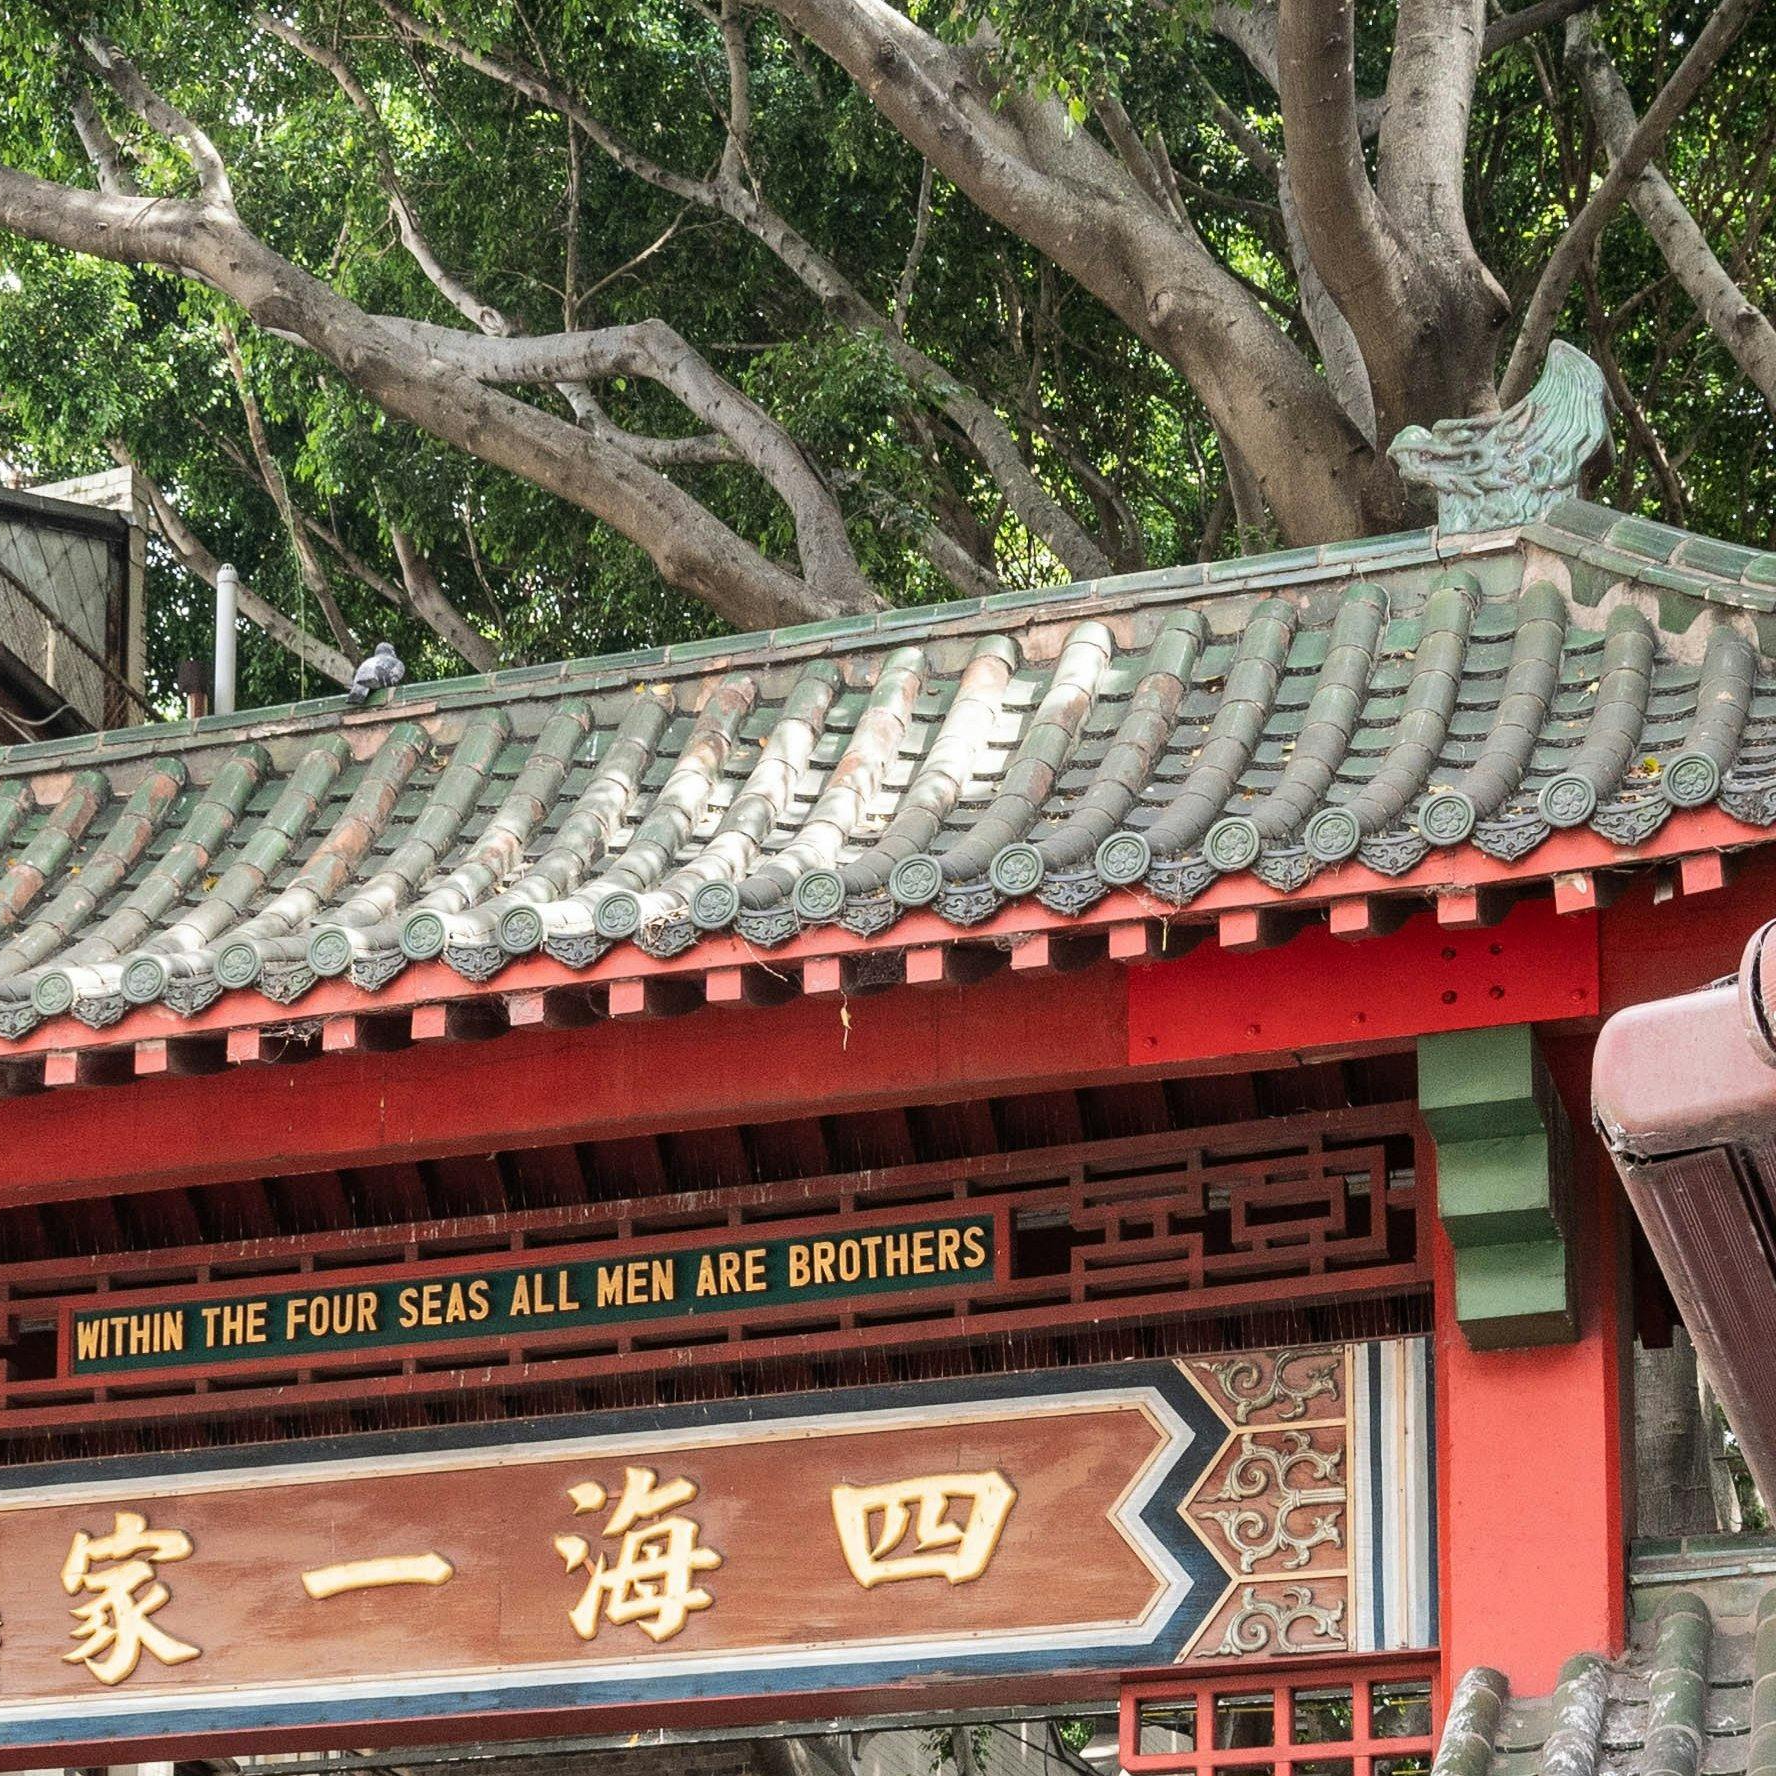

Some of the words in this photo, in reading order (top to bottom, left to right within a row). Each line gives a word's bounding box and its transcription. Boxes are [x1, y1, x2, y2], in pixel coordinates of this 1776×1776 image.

[77, 1310, 184, 1361] WITHIN
[201, 1301, 268, 1348] THE
[286, 1291, 378, 1340] FOUR
[398, 1280, 490, 1328] SEAS
[509, 1270, 579, 1316] ALL
[597, 1259, 674, 1307] MEN
[696, 1248, 767, 1297] ARE
[789, 1226, 986, 1288] BROTHERS
